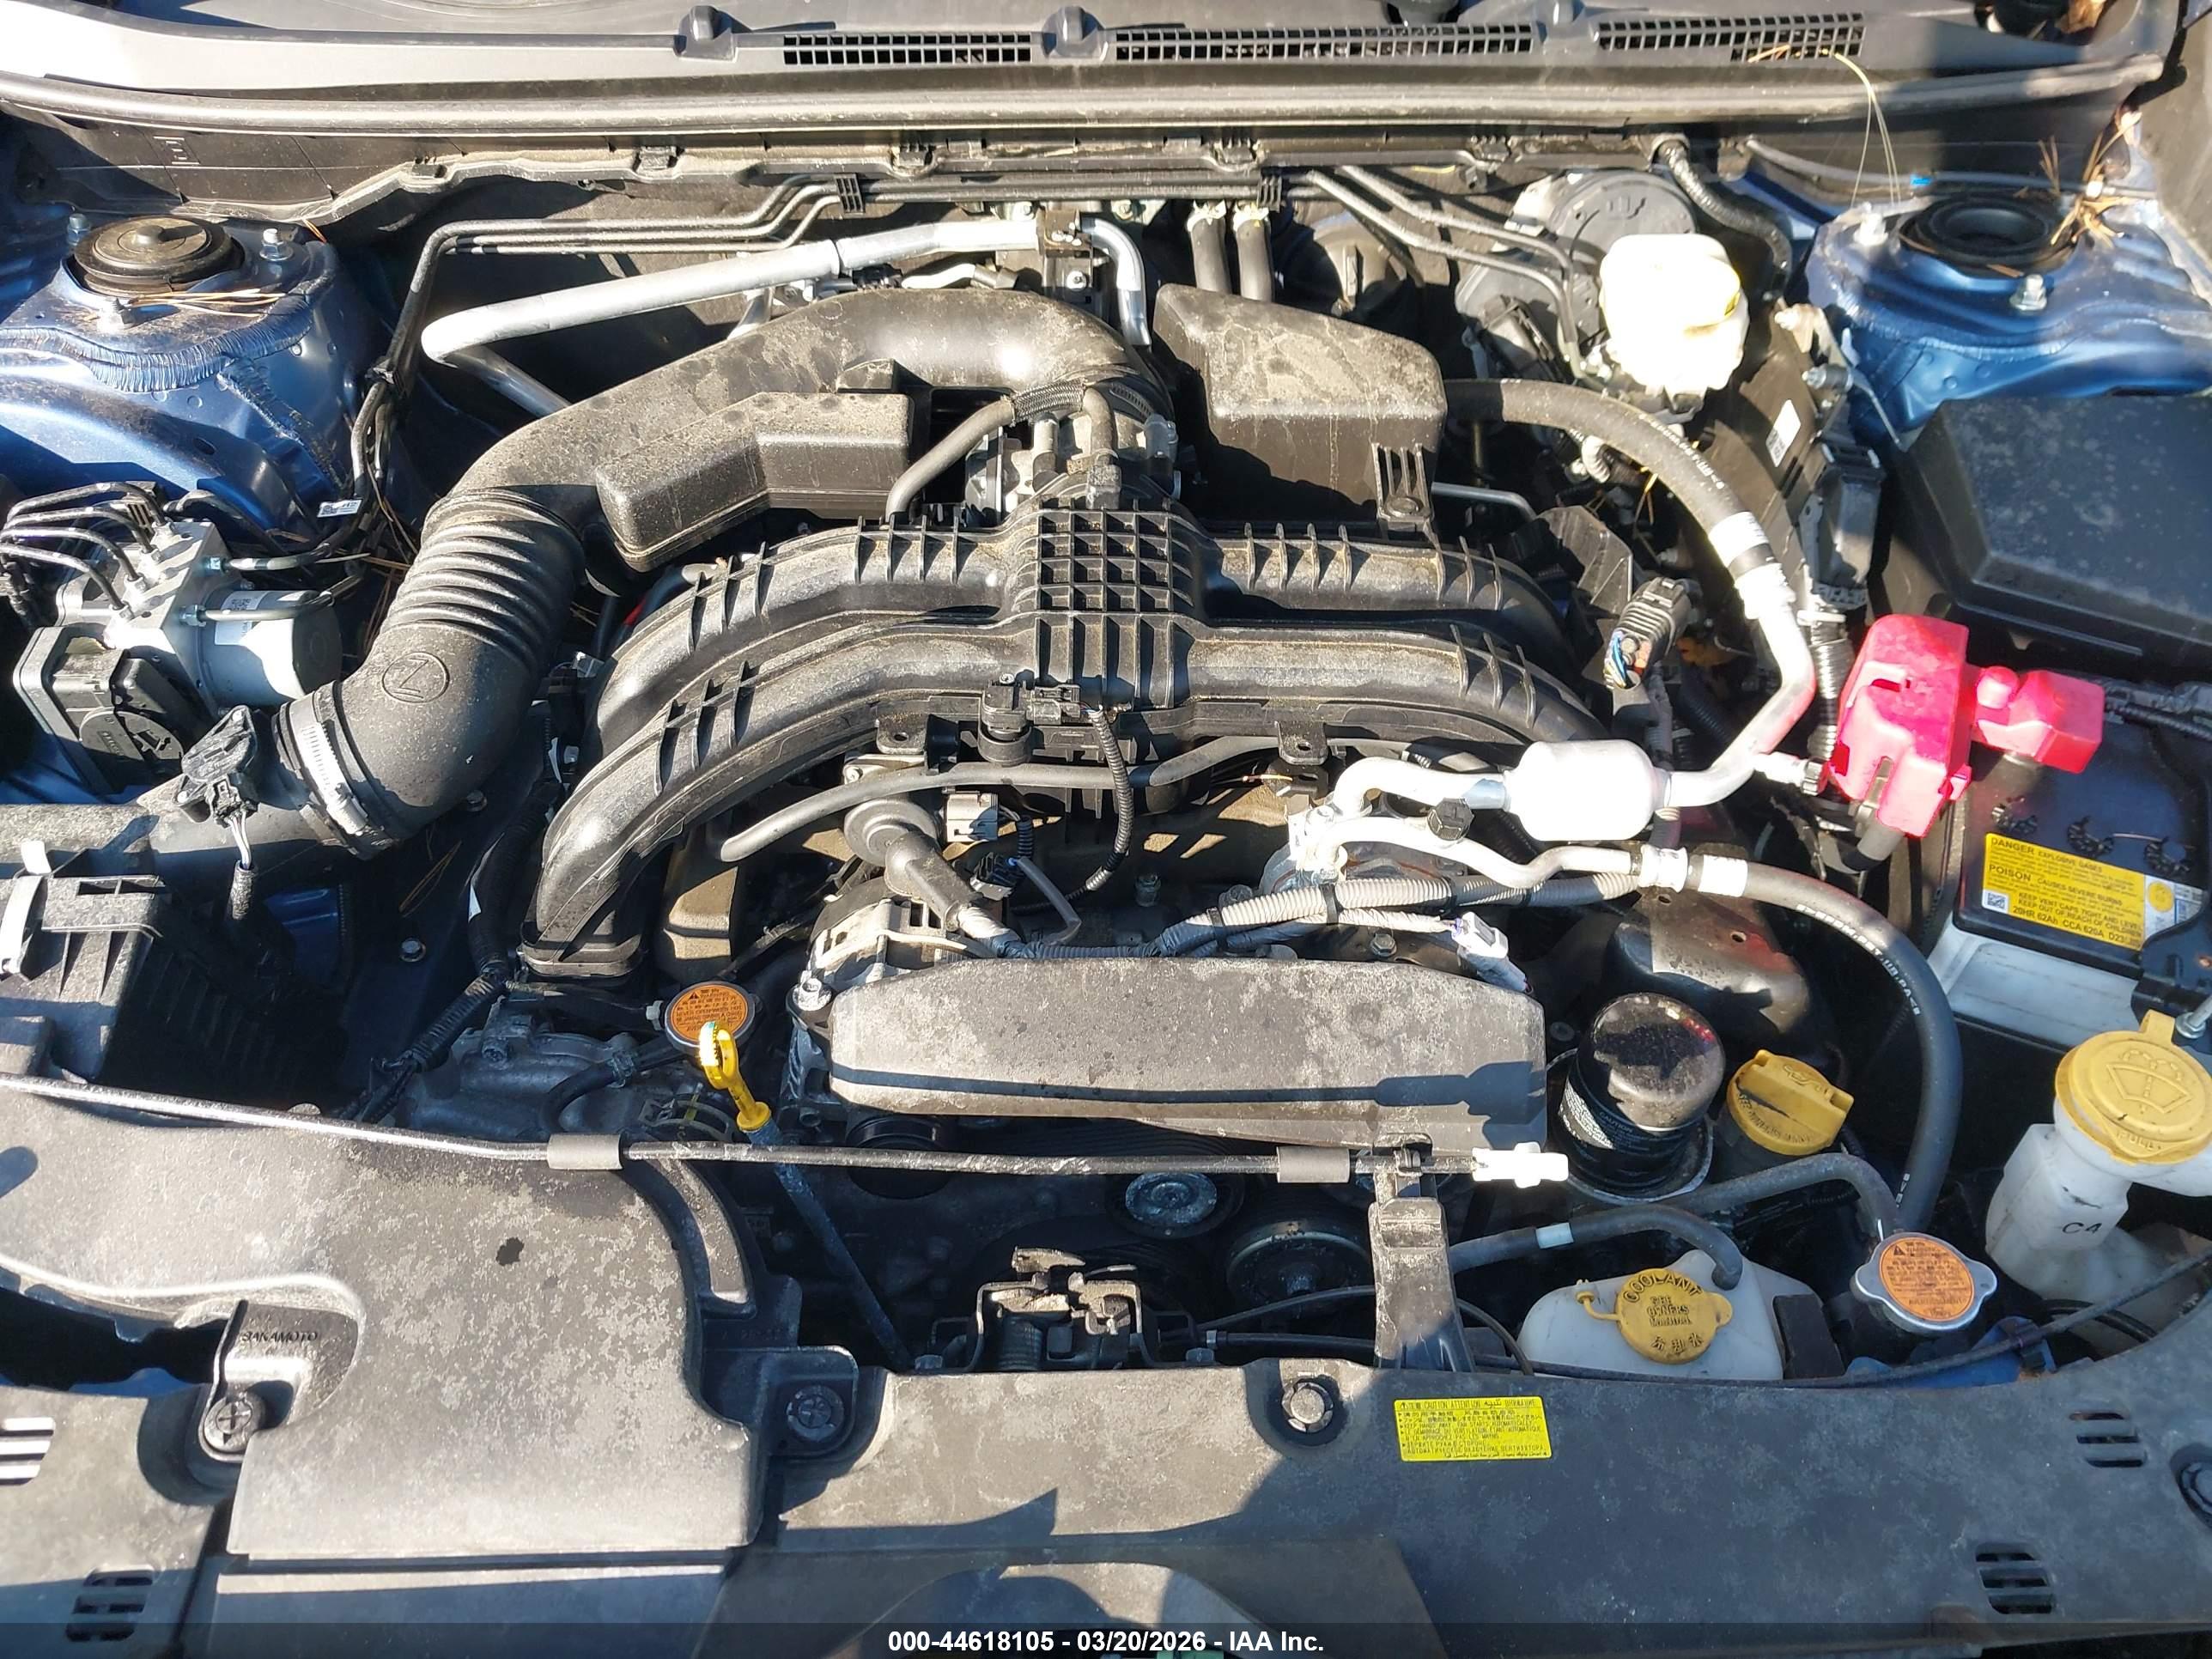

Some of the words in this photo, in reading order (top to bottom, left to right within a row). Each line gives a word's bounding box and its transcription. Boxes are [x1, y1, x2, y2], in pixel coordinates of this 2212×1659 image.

[1990, 837, 2035, 855] DANGER
[1989, 864, 2032, 882] POISON
[2037, 877, 2067, 891] CAUSES
[2068, 884, 2097, 898] SEVERE
[2097, 893, 2124, 906] BURNS
[2018, 892, 2038, 902] KEEP
[2059, 902, 2080, 913] CAPS
[2018, 899, 2038, 908] KEEP
[2039, 903, 2053, 913] OUT
[2013, 905, 2035, 919] 20HR
[2037, 912, 2059, 926] 62Ah
[2062, 919, 2082, 932] CCA
[2083, 927, 2105, 939] 620A
[1598, 1110, 1635, 1133] CAUTION
[2062, 1221, 2103, 1235] C4
[1622, 1272, 1705, 1304] COOLANT
[240, 1331, 319, 1343] SAKAMOTO
[1424, 1401, 1448, 1410] CAUTION
